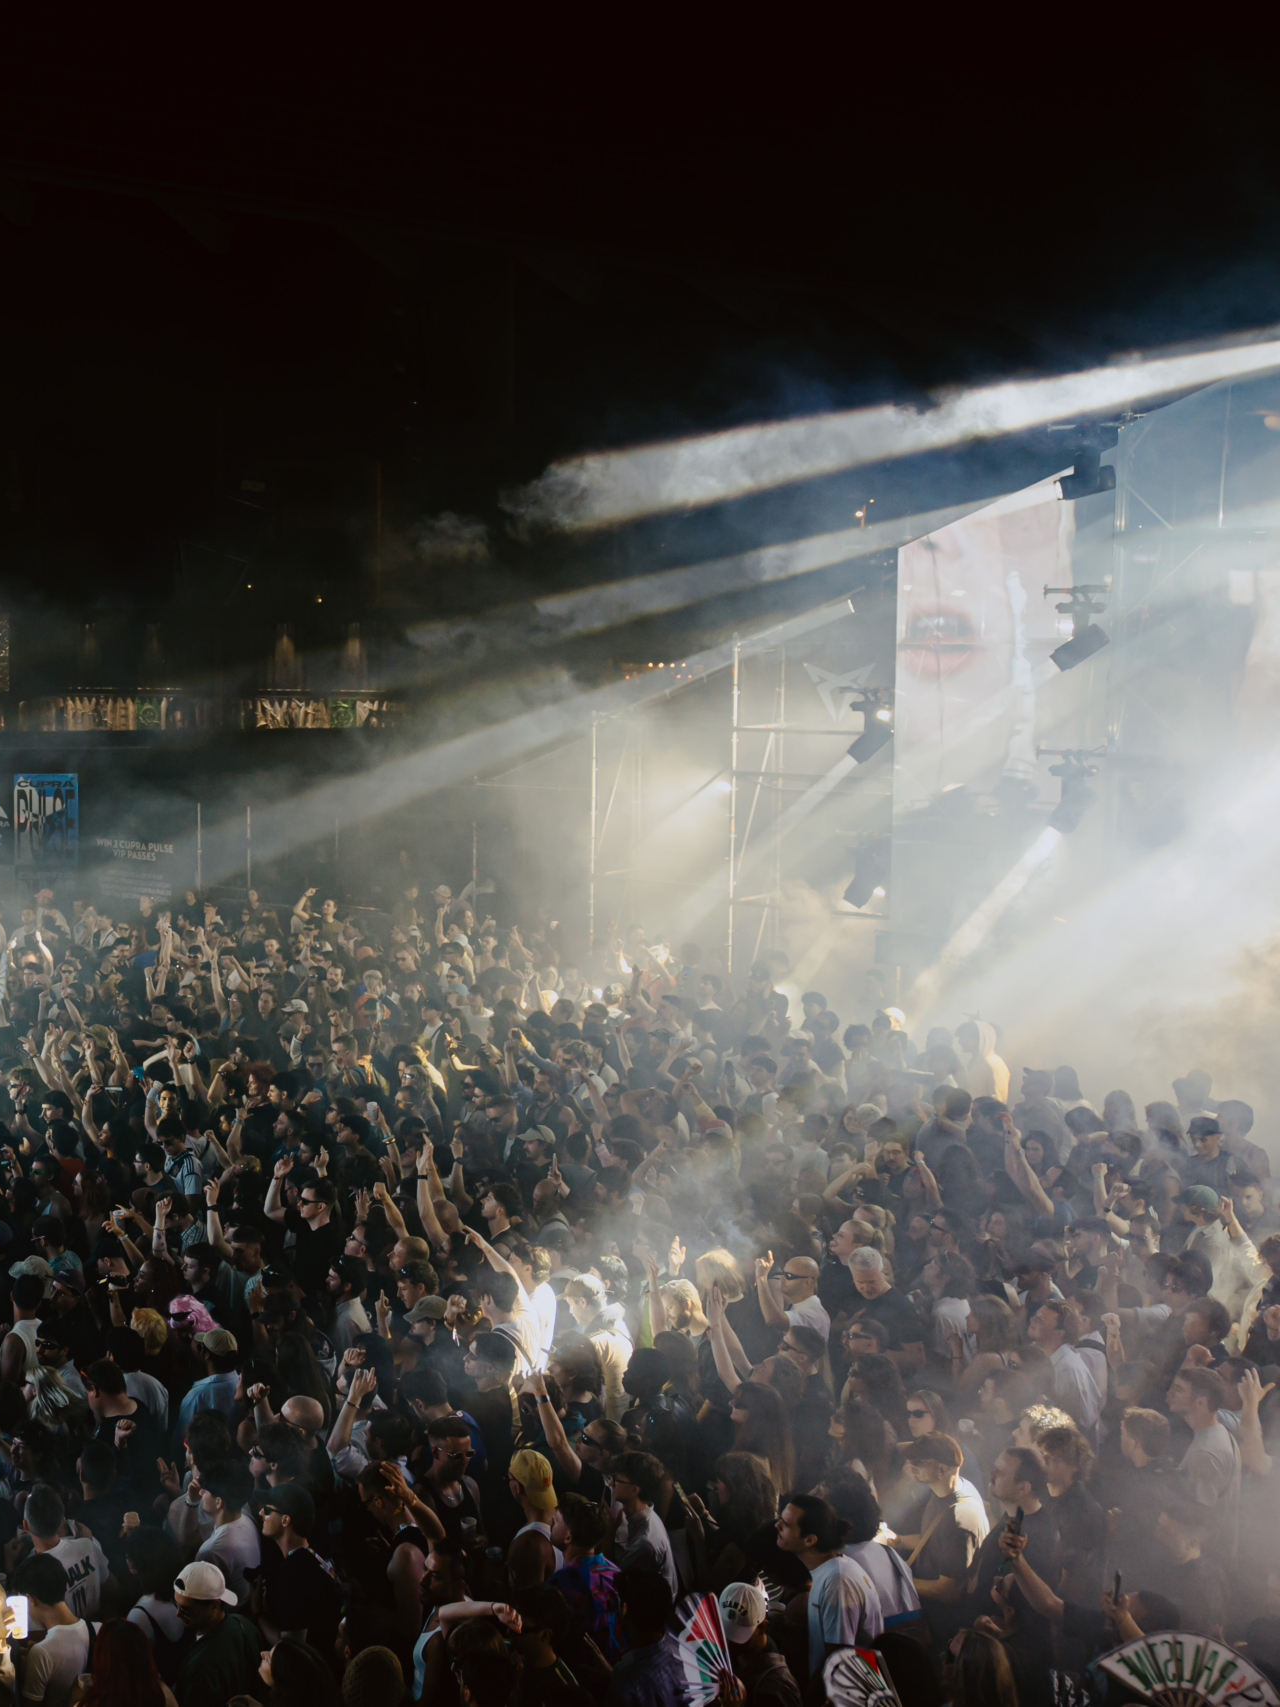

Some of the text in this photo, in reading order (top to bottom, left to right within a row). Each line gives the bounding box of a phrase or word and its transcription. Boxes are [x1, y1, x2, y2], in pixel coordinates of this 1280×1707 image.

[17, 780, 75, 788] CUPRA
[96, 838, 174, 854] WIN 2 CUPRA PULSE
[112, 849, 157, 861] VIP PASSES
[67, 1555, 96, 1588] ALK
